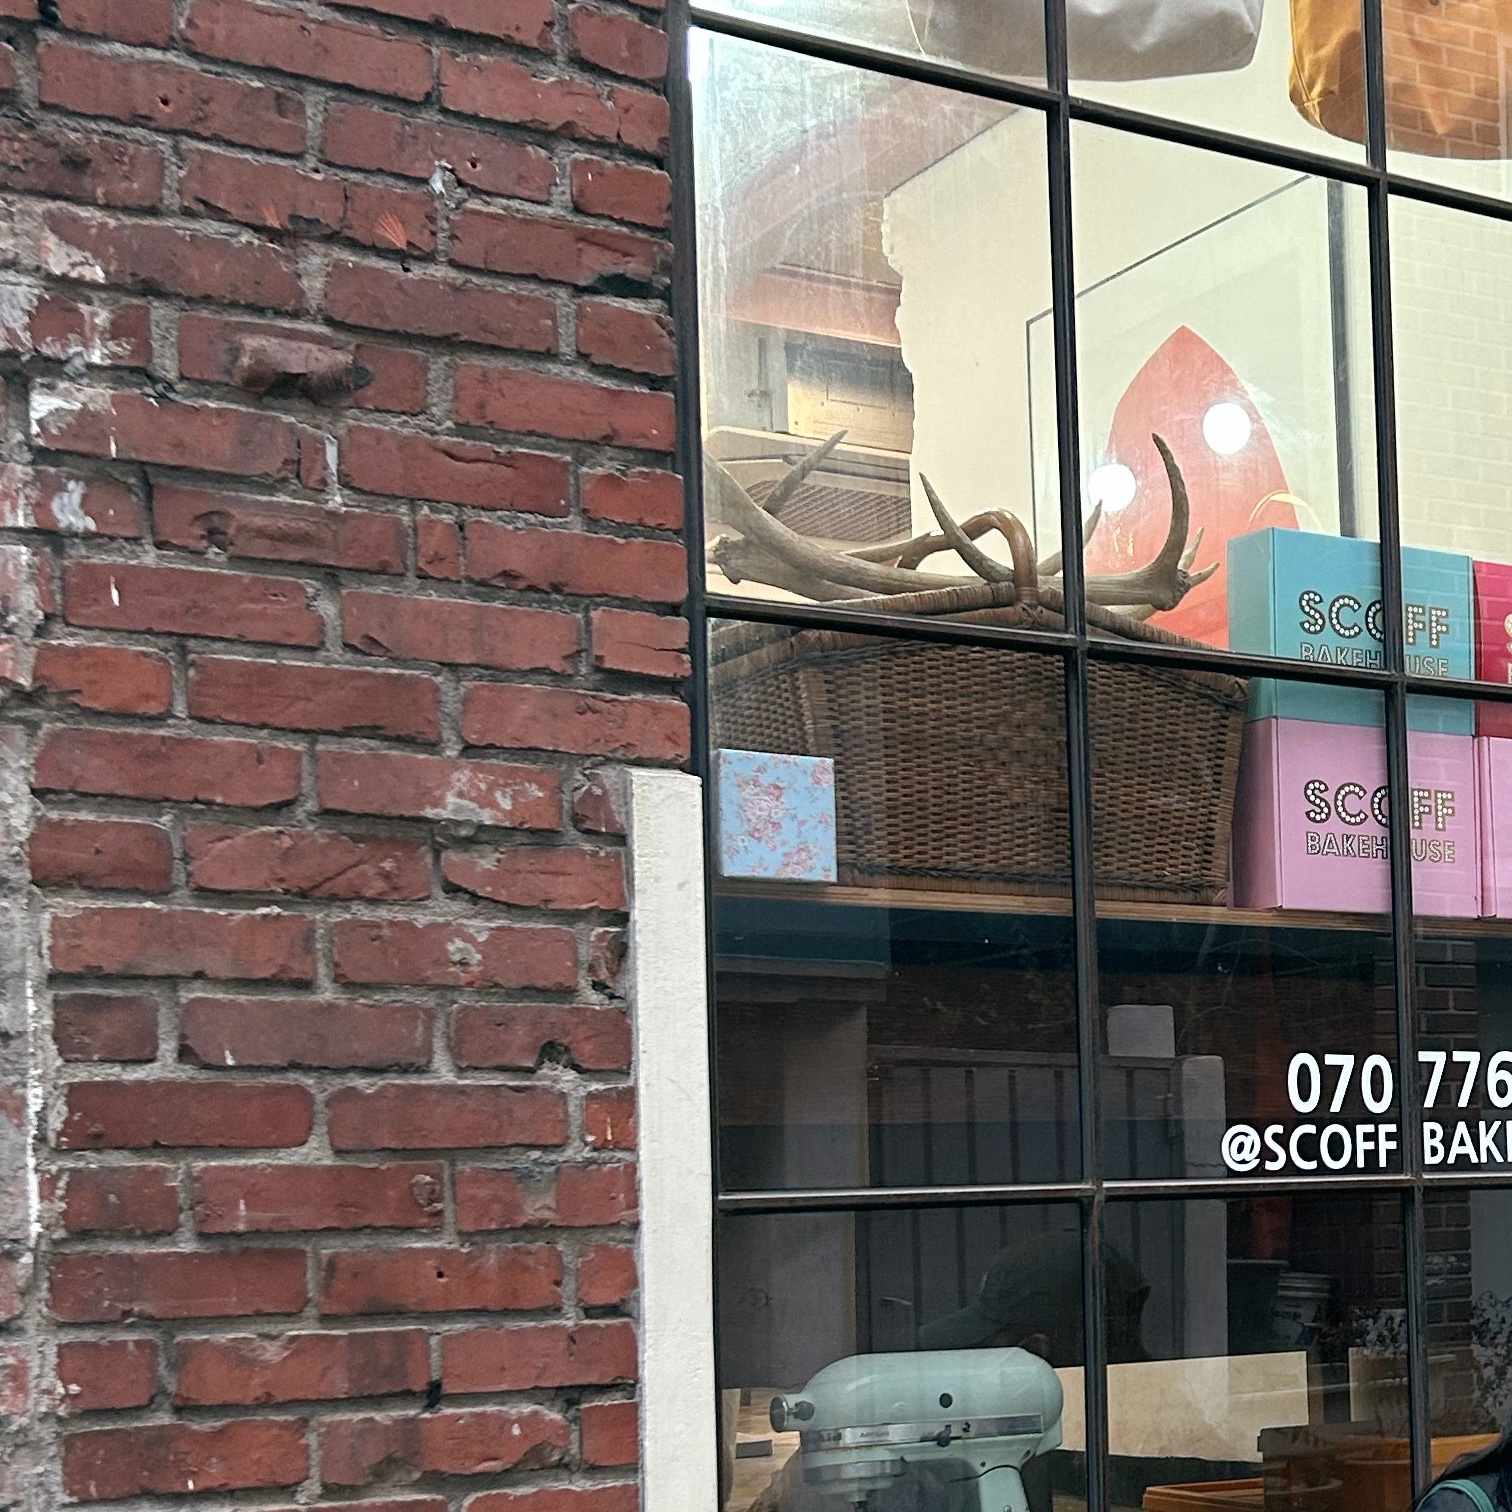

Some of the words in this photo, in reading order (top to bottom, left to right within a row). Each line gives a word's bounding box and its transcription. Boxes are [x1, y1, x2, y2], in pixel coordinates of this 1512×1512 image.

[1300, 642, 1449, 677] BAKEHUSE
[1306, 831, 1455, 863] BAKEHUSE
[1287, 1052, 1393, 1114] 070
[1221, 1123, 1398, 1172] @SCOFF
